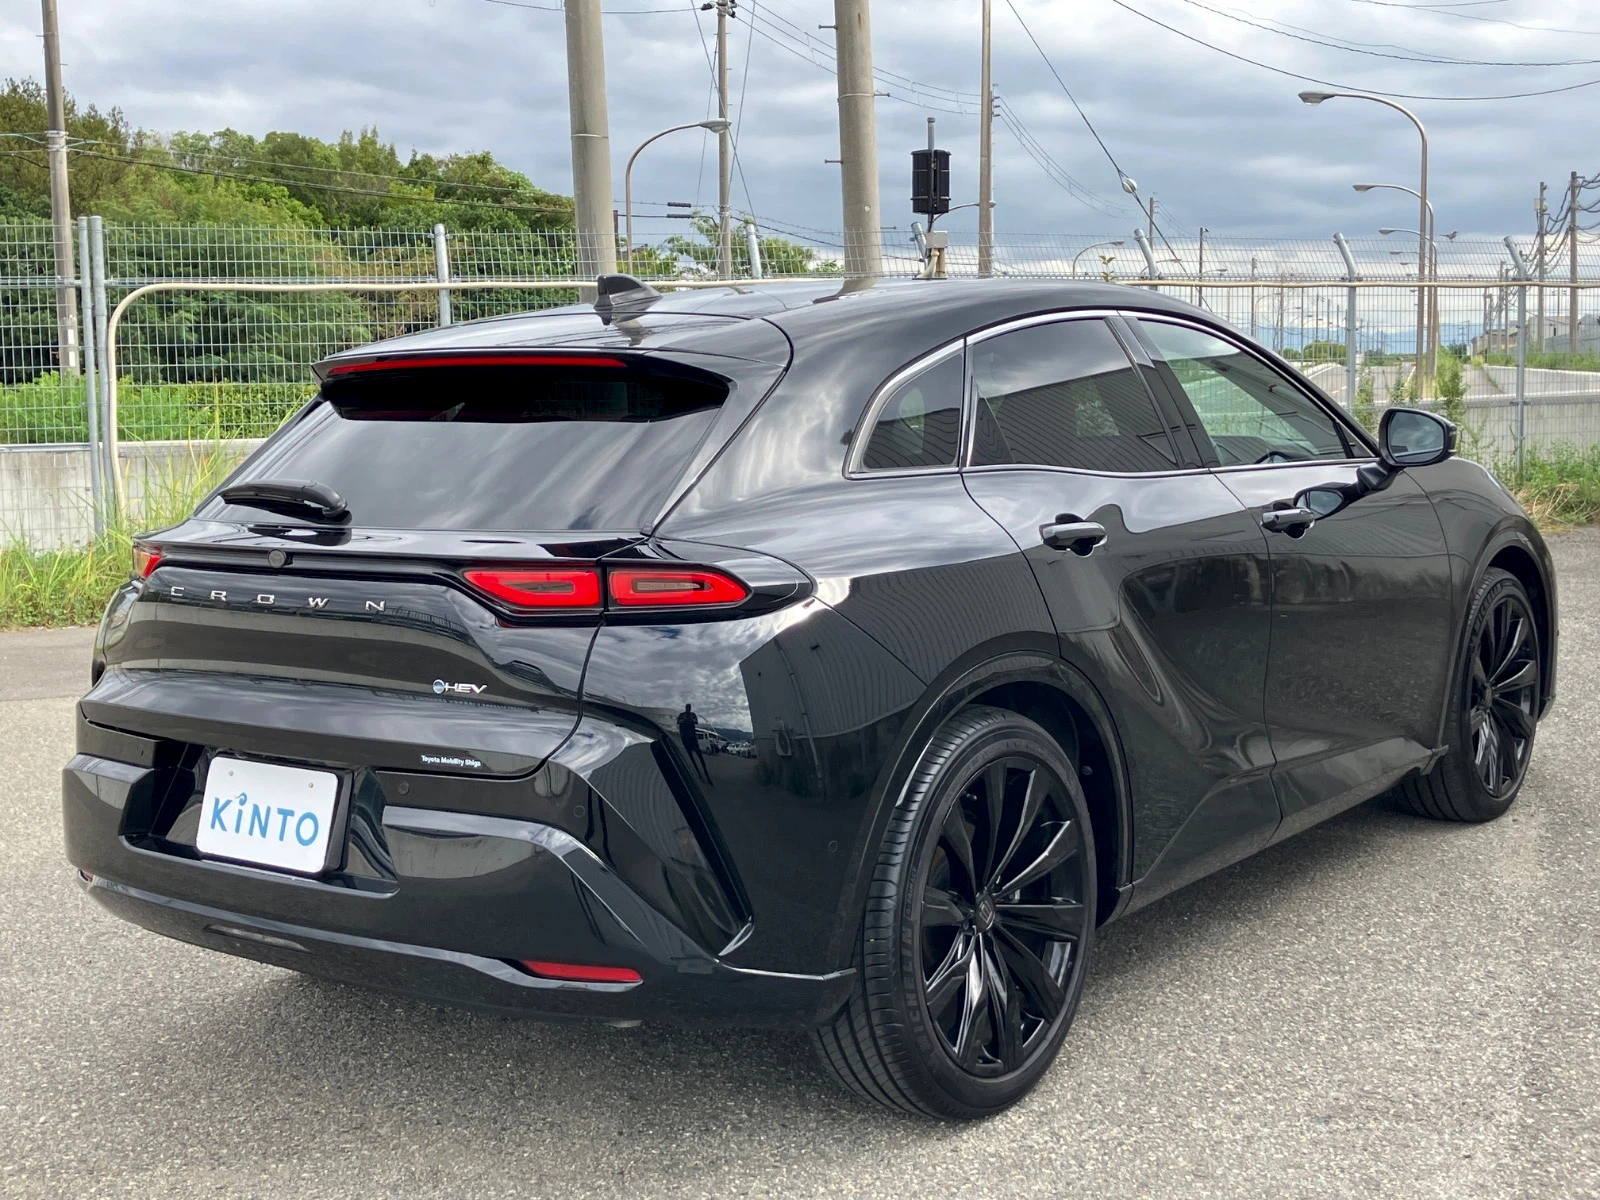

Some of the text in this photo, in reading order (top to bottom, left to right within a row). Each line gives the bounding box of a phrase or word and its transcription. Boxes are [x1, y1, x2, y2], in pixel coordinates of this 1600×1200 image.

[170, 586, 386, 611] CROWN
[444, 682, 487, 694] HEV
[421, 755, 481, 768] Toyota Mobility Shiga
